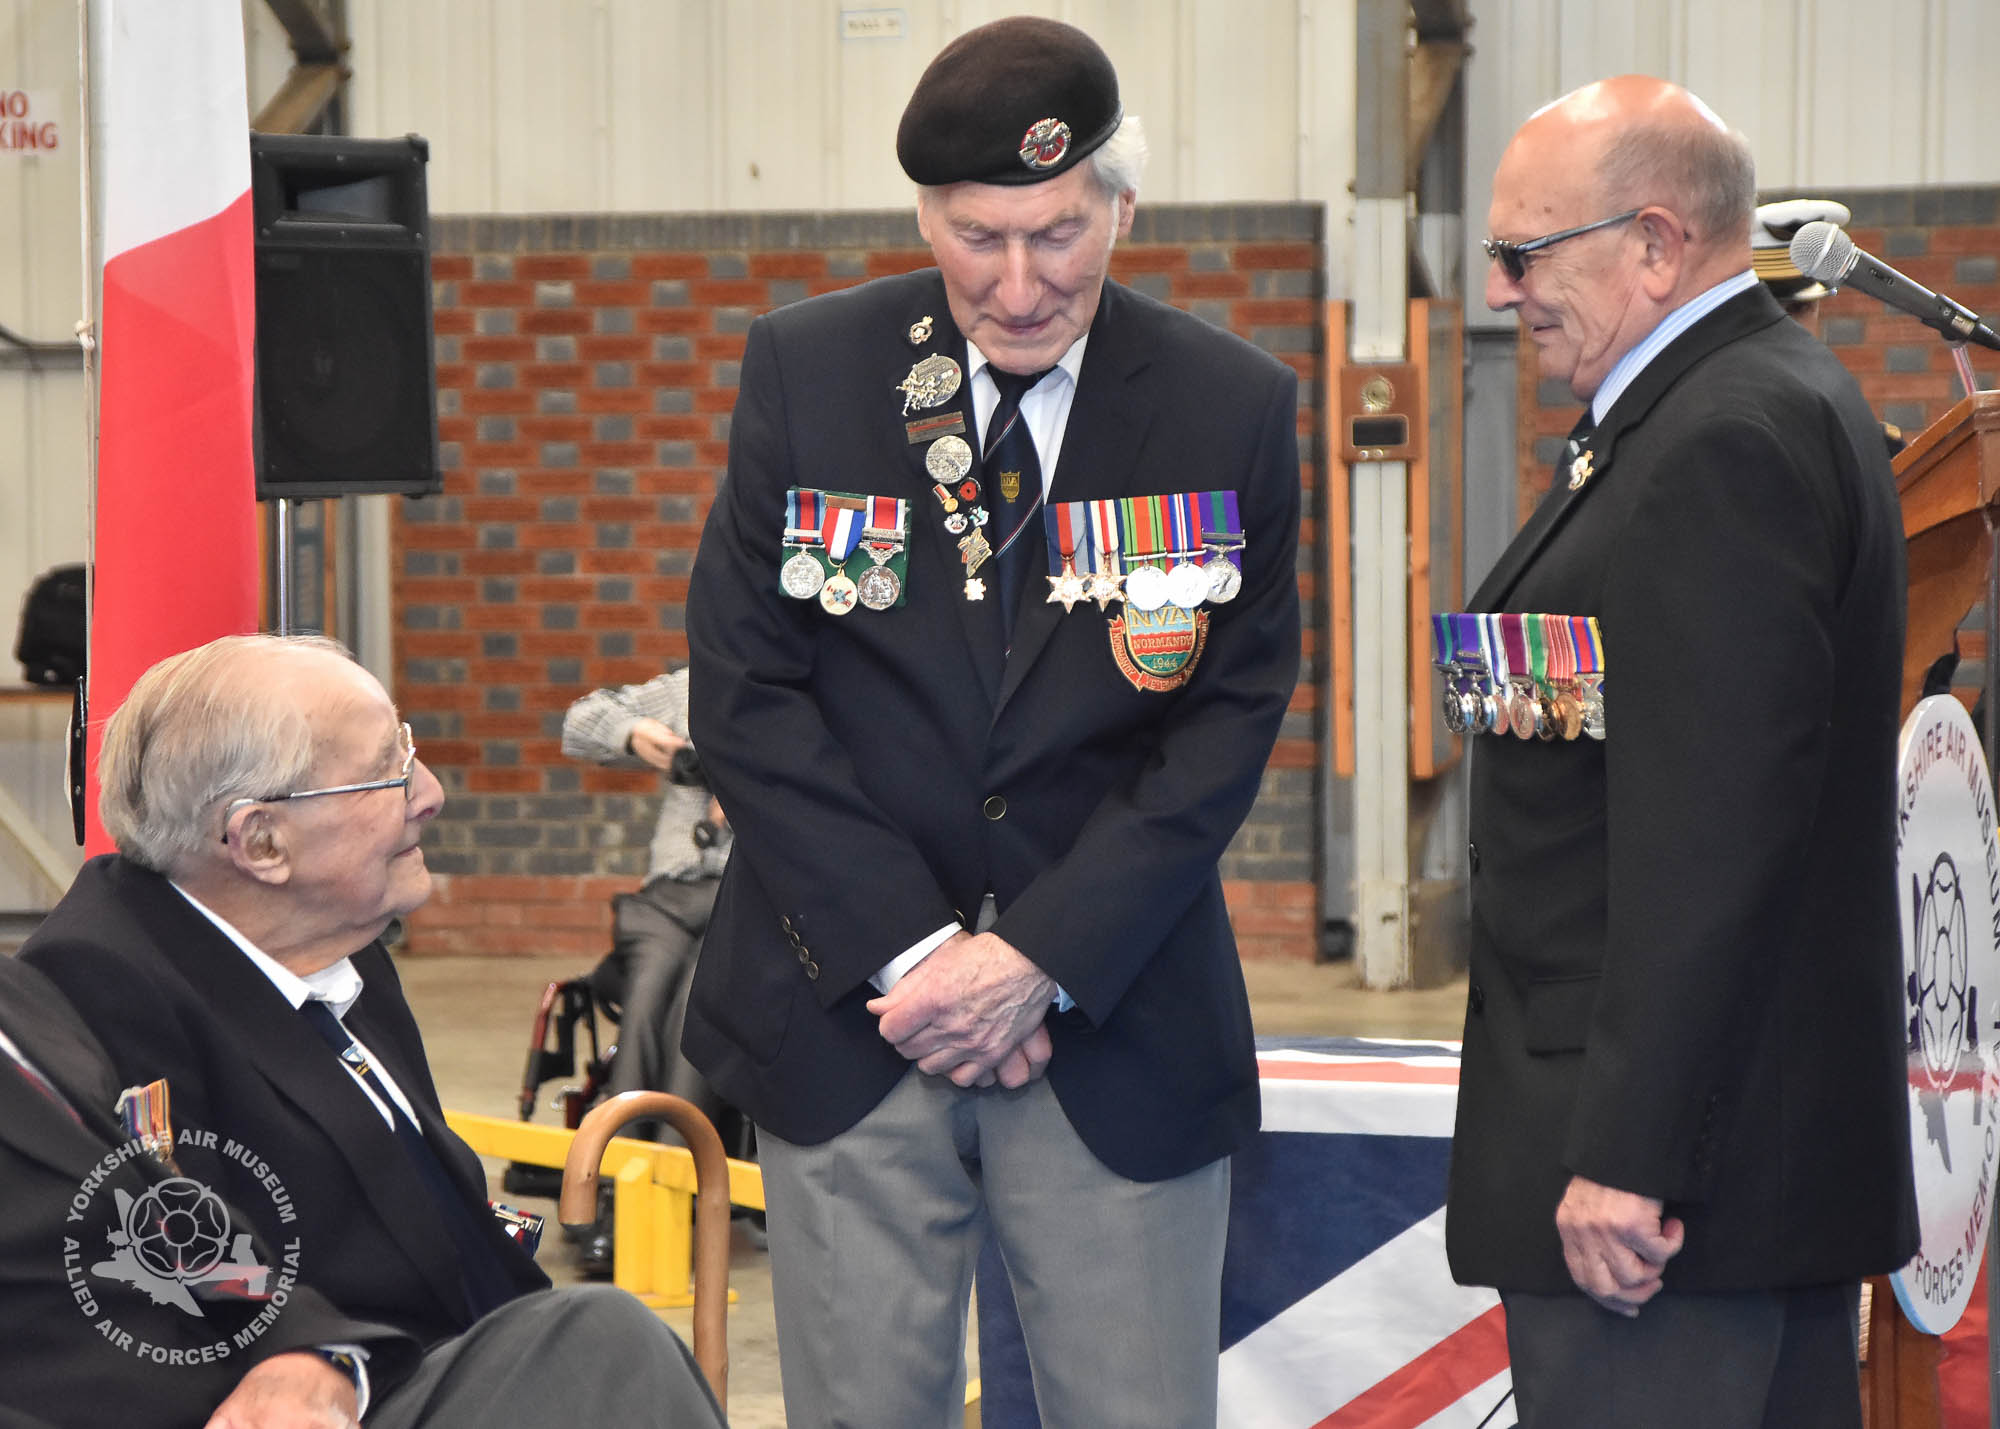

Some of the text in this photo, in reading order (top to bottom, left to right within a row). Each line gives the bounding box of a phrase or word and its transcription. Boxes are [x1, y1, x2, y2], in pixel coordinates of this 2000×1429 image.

[1129, 606, 1192, 627] NVA
[1112, 631, 1136, 676] NORMANDY
[1133, 635, 1193, 649] NORMANDY
[1152, 657, 1177, 669] 1944
[1946, 721, 1967, 772] AIR
[1967, 752, 2000, 951] MUSEUM
[1914, 1247, 1964, 1305] FORCES
